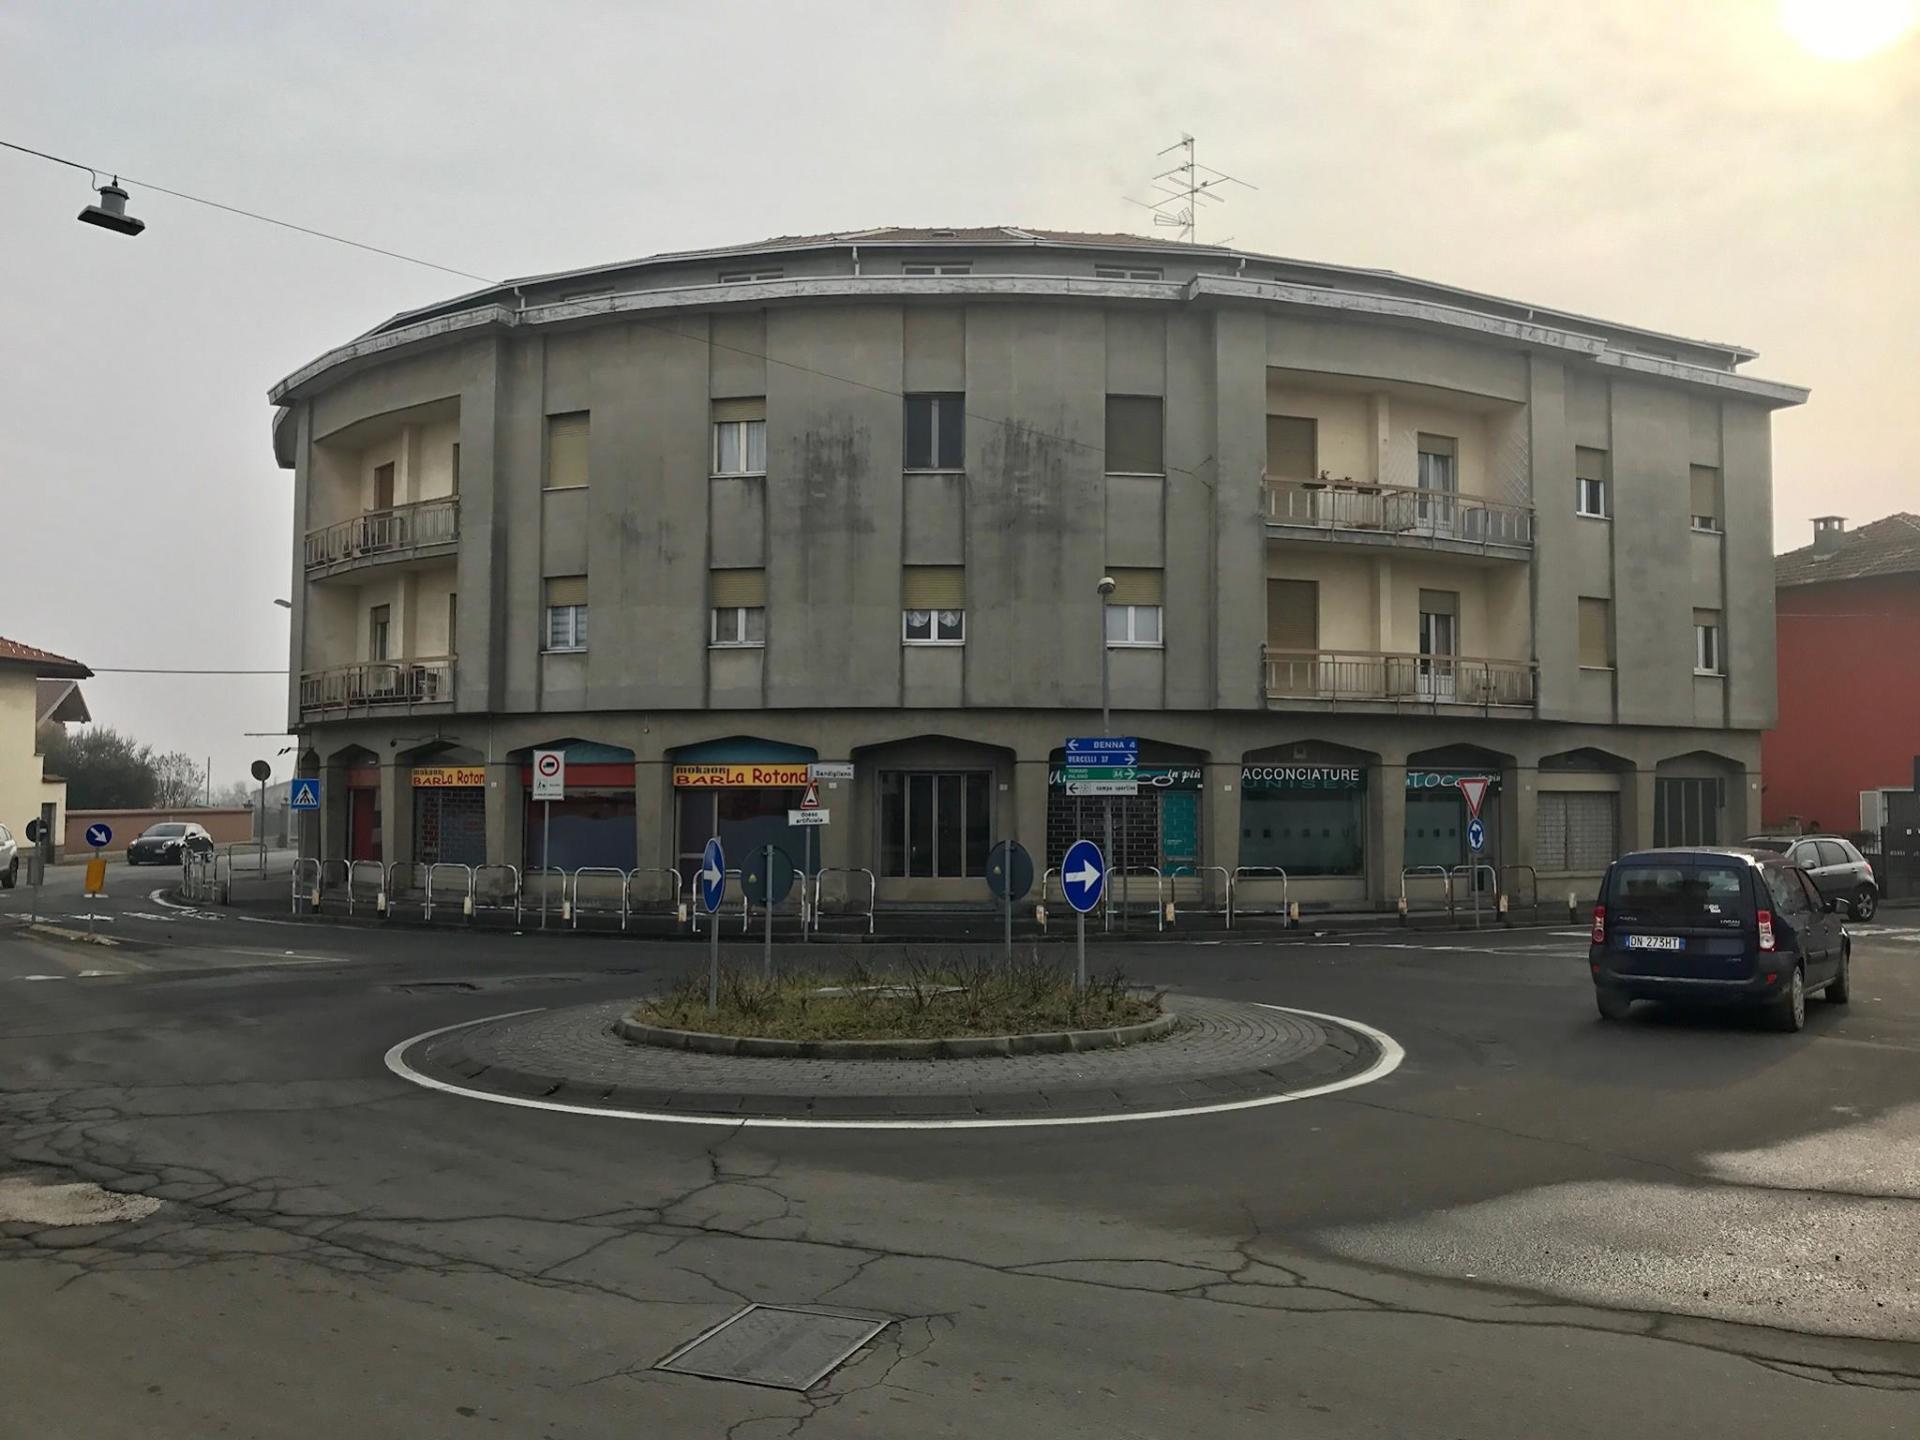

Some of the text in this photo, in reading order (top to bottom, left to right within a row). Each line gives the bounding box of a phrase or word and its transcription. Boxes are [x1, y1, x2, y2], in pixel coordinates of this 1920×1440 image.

[1093, 741, 1136, 749] BENNA 4
[1067, 755, 1097, 763] VERCELLI
[413, 776, 441, 785] BAR
[441, 774, 453, 785] La
[676, 775, 725, 785] BAR
[726, 767, 745, 784] La
[1241, 767, 1360, 781] ACCONCIATURE
[1243, 780, 1358, 789] UNISEX
[1631, 936, 1679, 948] DN 273HT
